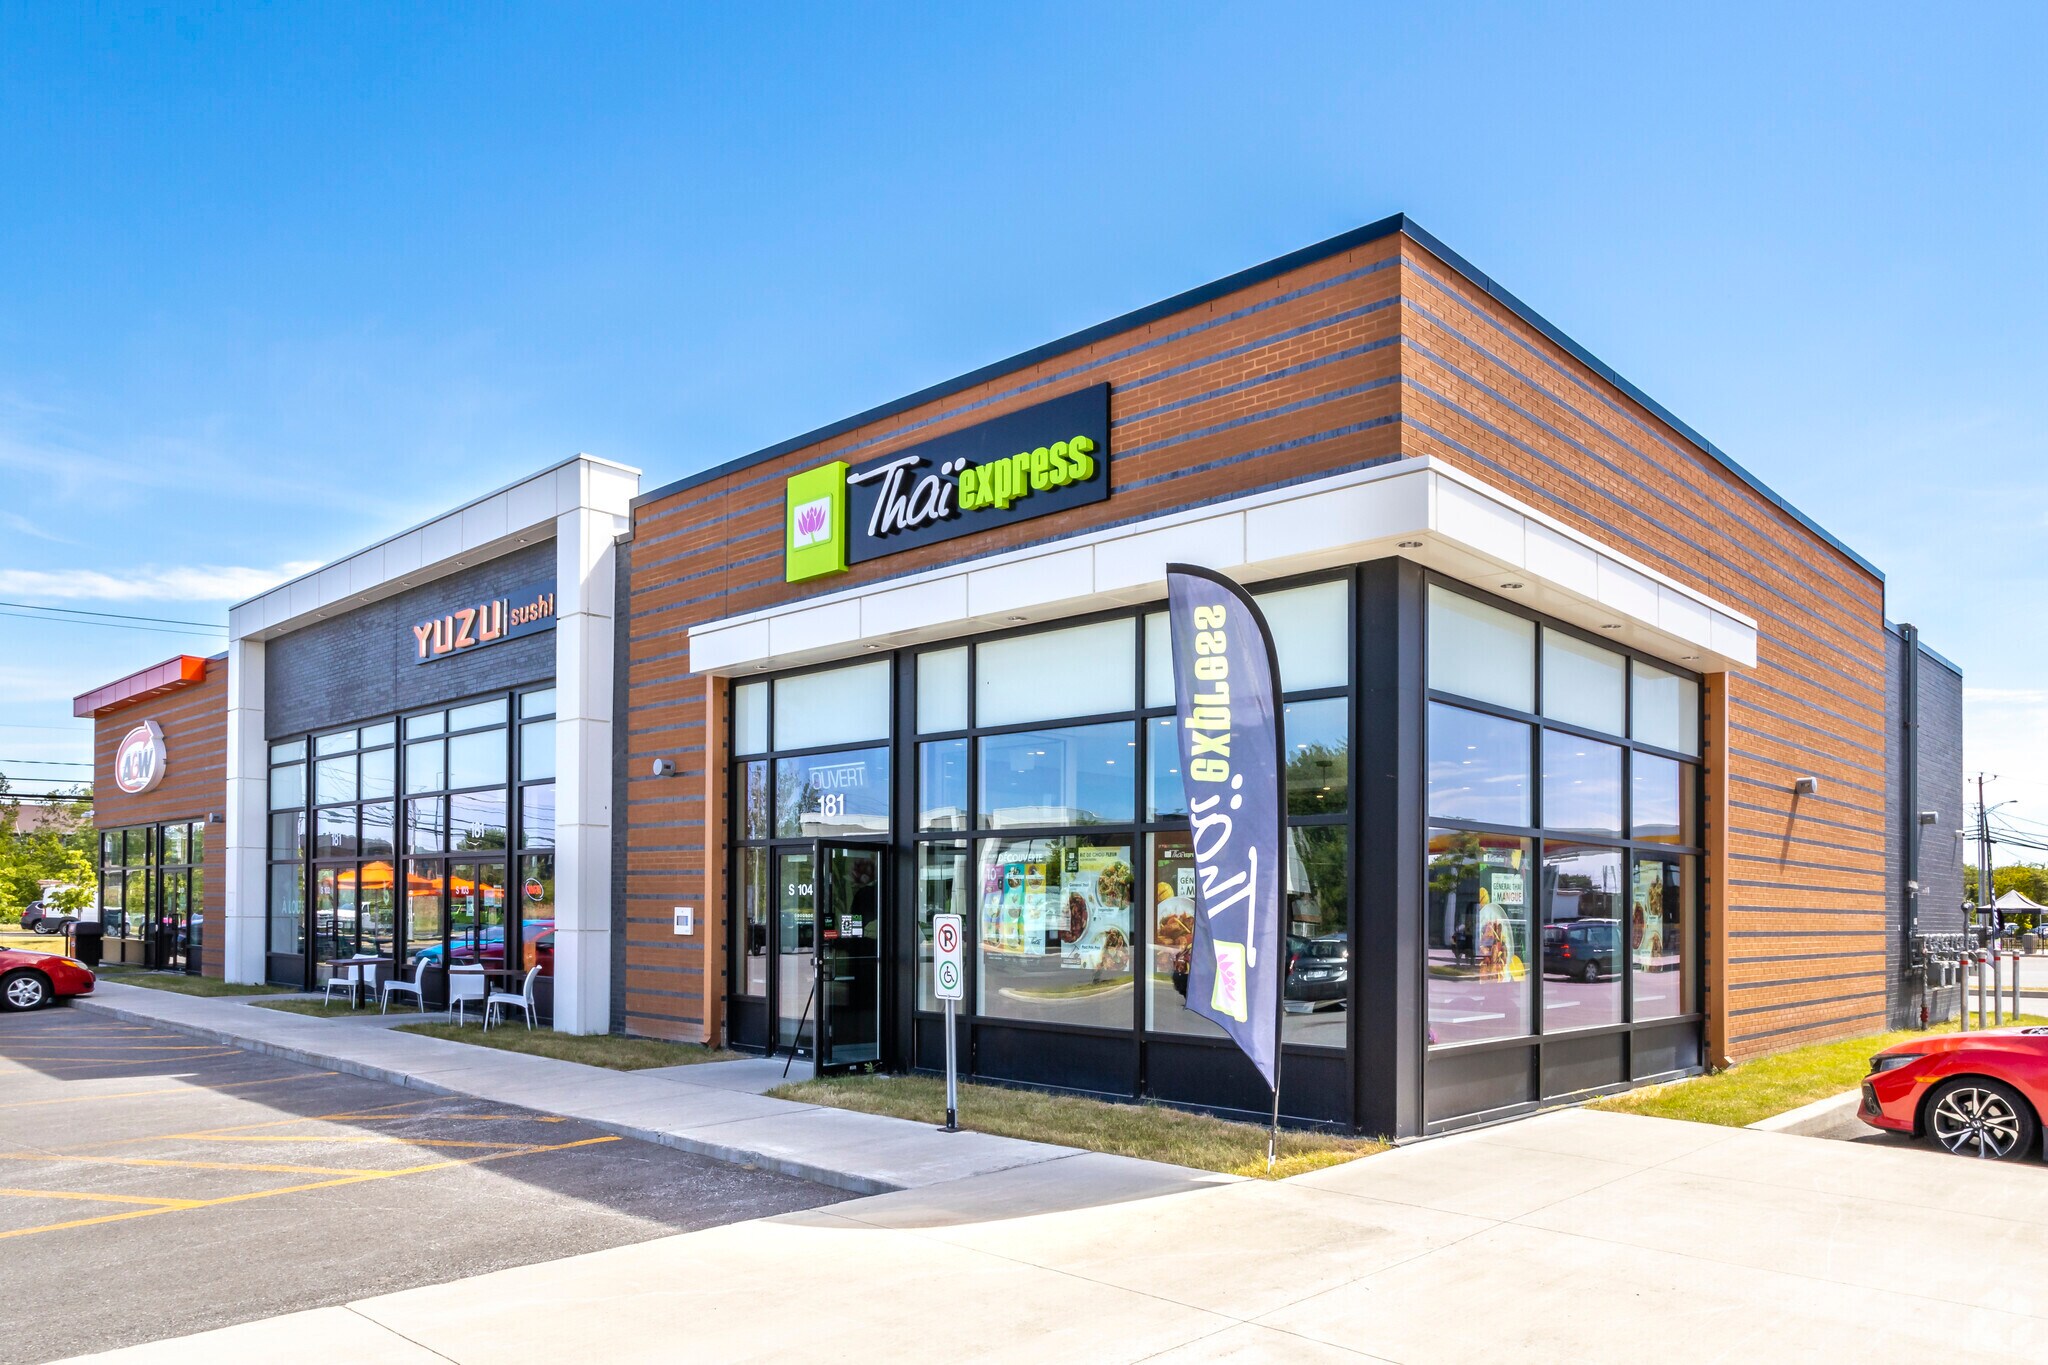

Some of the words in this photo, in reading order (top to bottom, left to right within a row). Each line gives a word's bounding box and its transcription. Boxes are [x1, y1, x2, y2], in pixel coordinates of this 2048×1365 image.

[847, 455, 966, 536] Thaï
[958, 435, 1094, 510] express
[413, 600, 501, 658] YUZU
[511, 593, 555, 626] sushi
[811, 767, 865, 790] OUVERT
[817, 793, 844, 817] 181
[331, 832, 342, 846] 181
[471, 821, 485, 838] 181
[788, 884, 795, 896] S
[798, 884, 813, 896] 104
